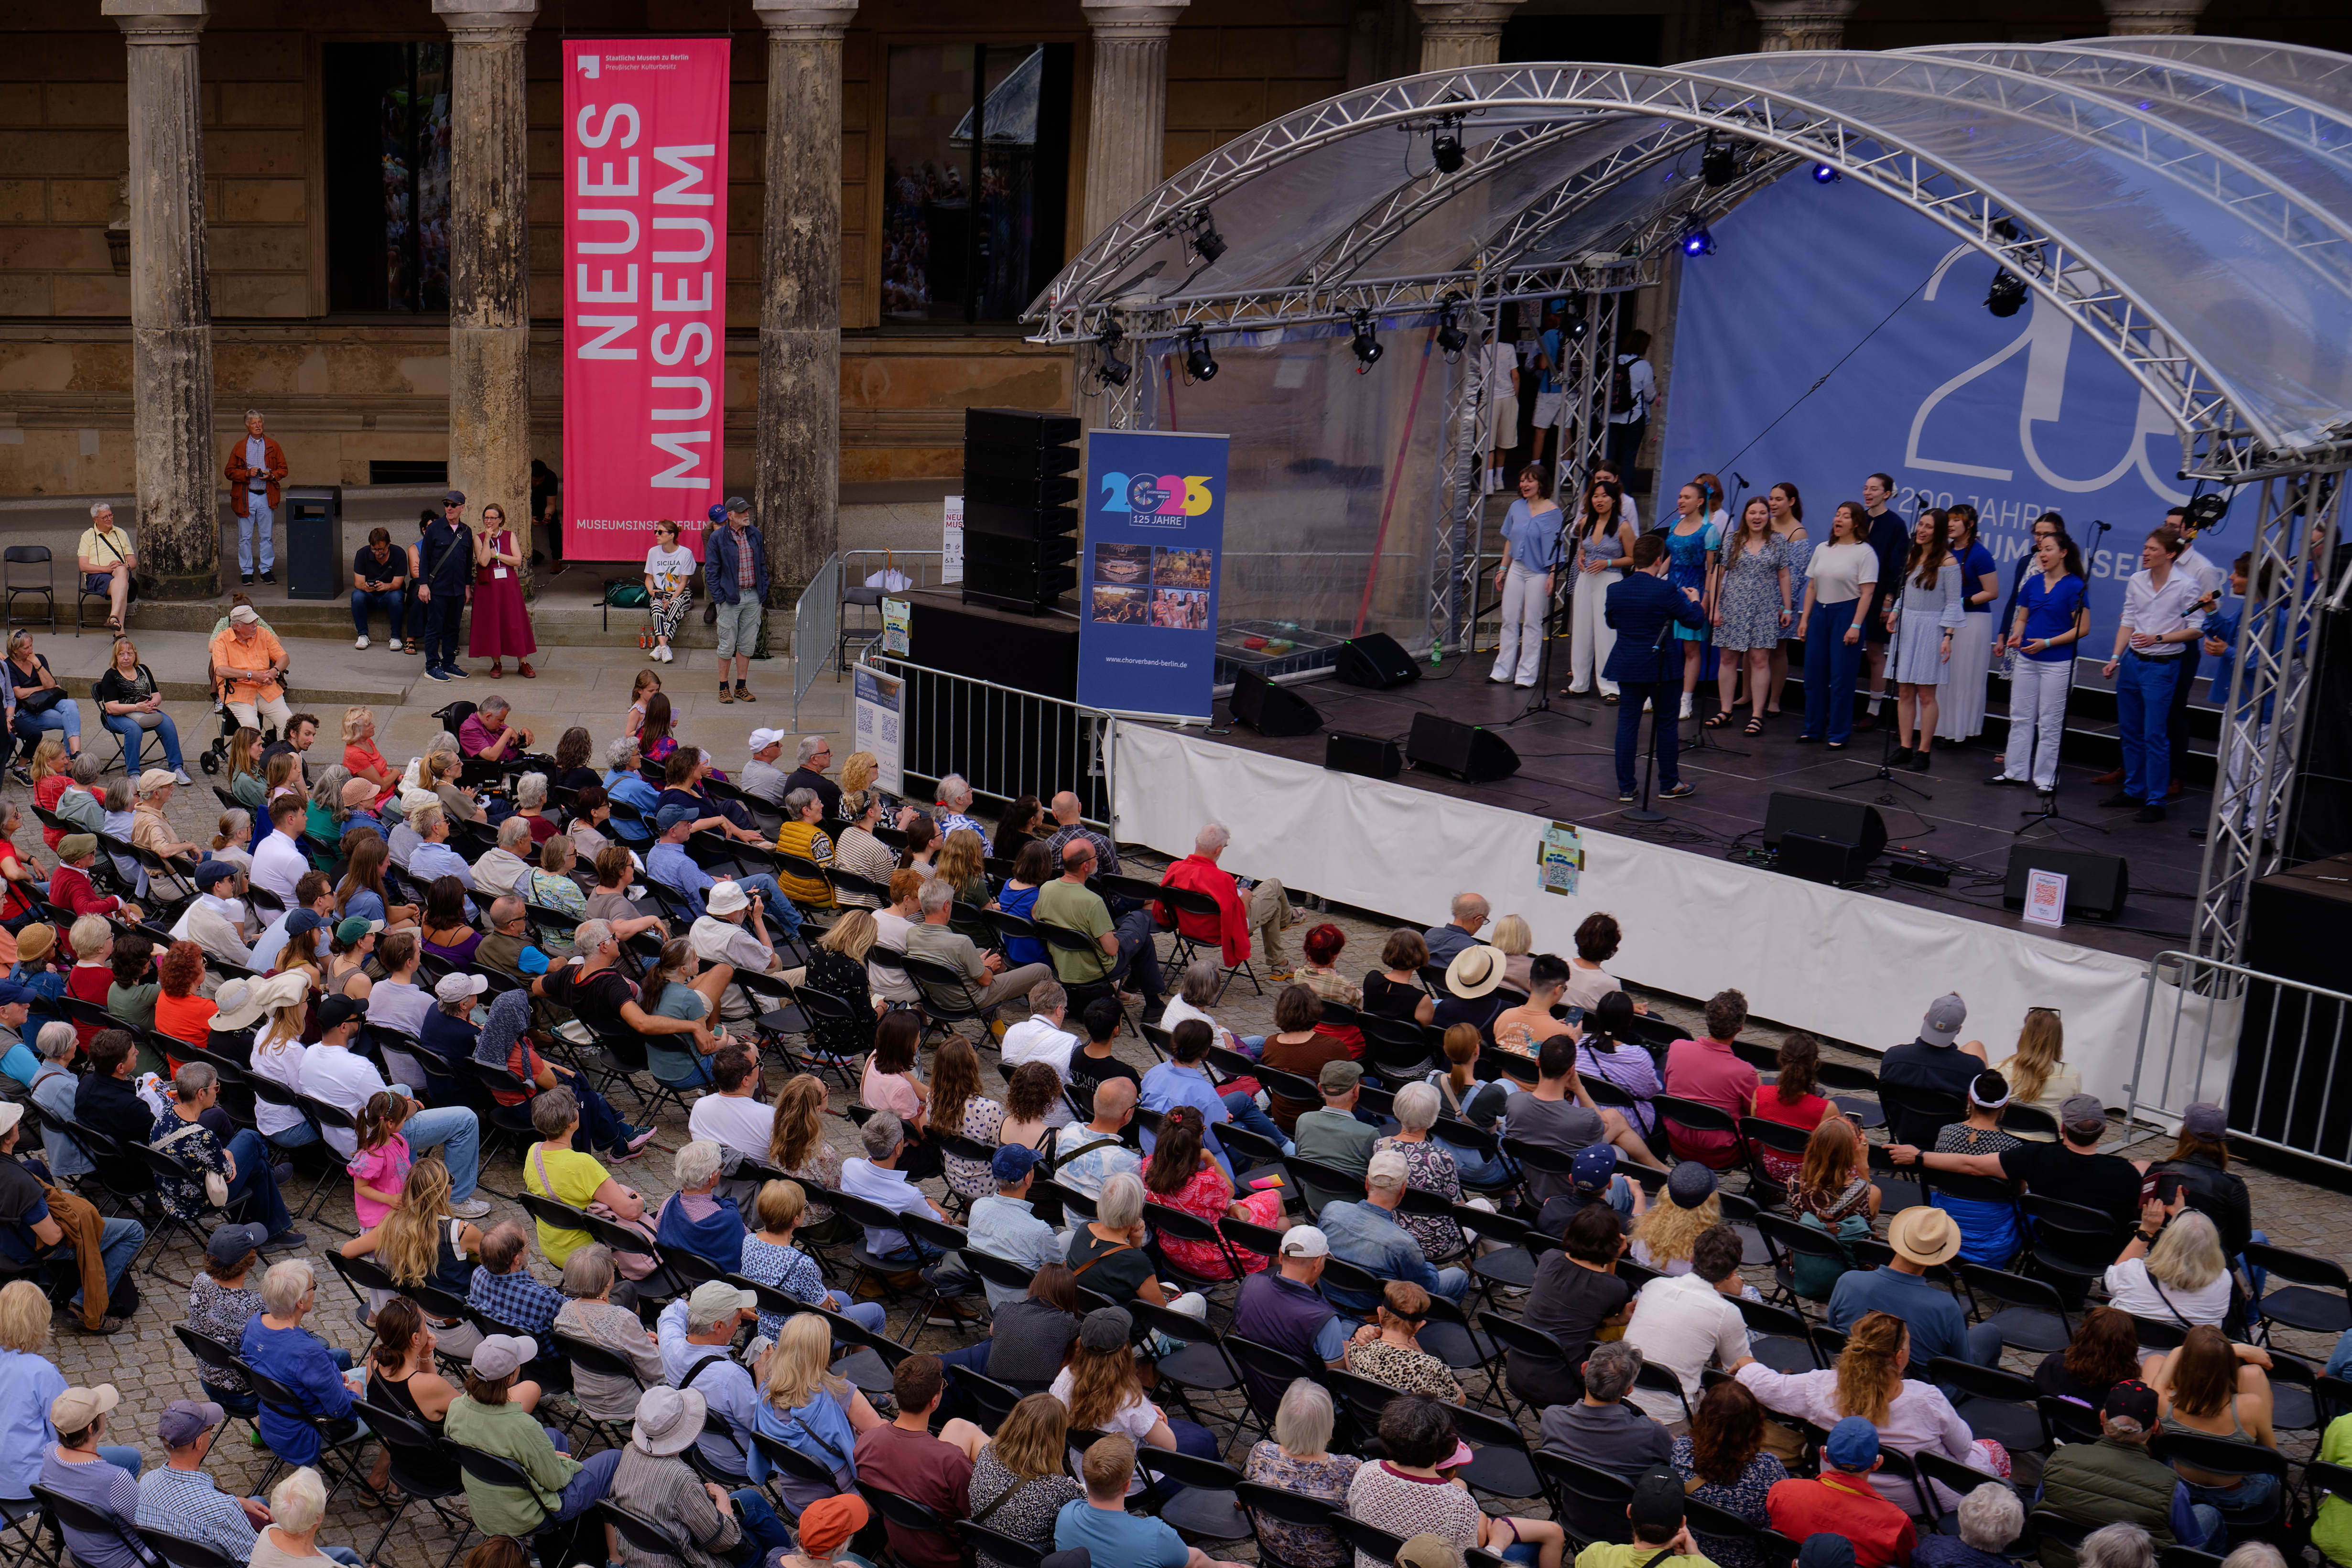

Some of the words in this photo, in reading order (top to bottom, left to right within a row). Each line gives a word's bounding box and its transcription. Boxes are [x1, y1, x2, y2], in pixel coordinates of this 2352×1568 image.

[577, 103, 640, 360] NEUES
[650, 144, 715, 489] MUSEUM
[576, 519, 660, 530] MUSEUMSINSE
[1133, 515, 1150, 524] 125
[1151, 516, 1182, 526] JAHRE
[1106, 657, 1188, 668] www.chorverband-berlin.de
